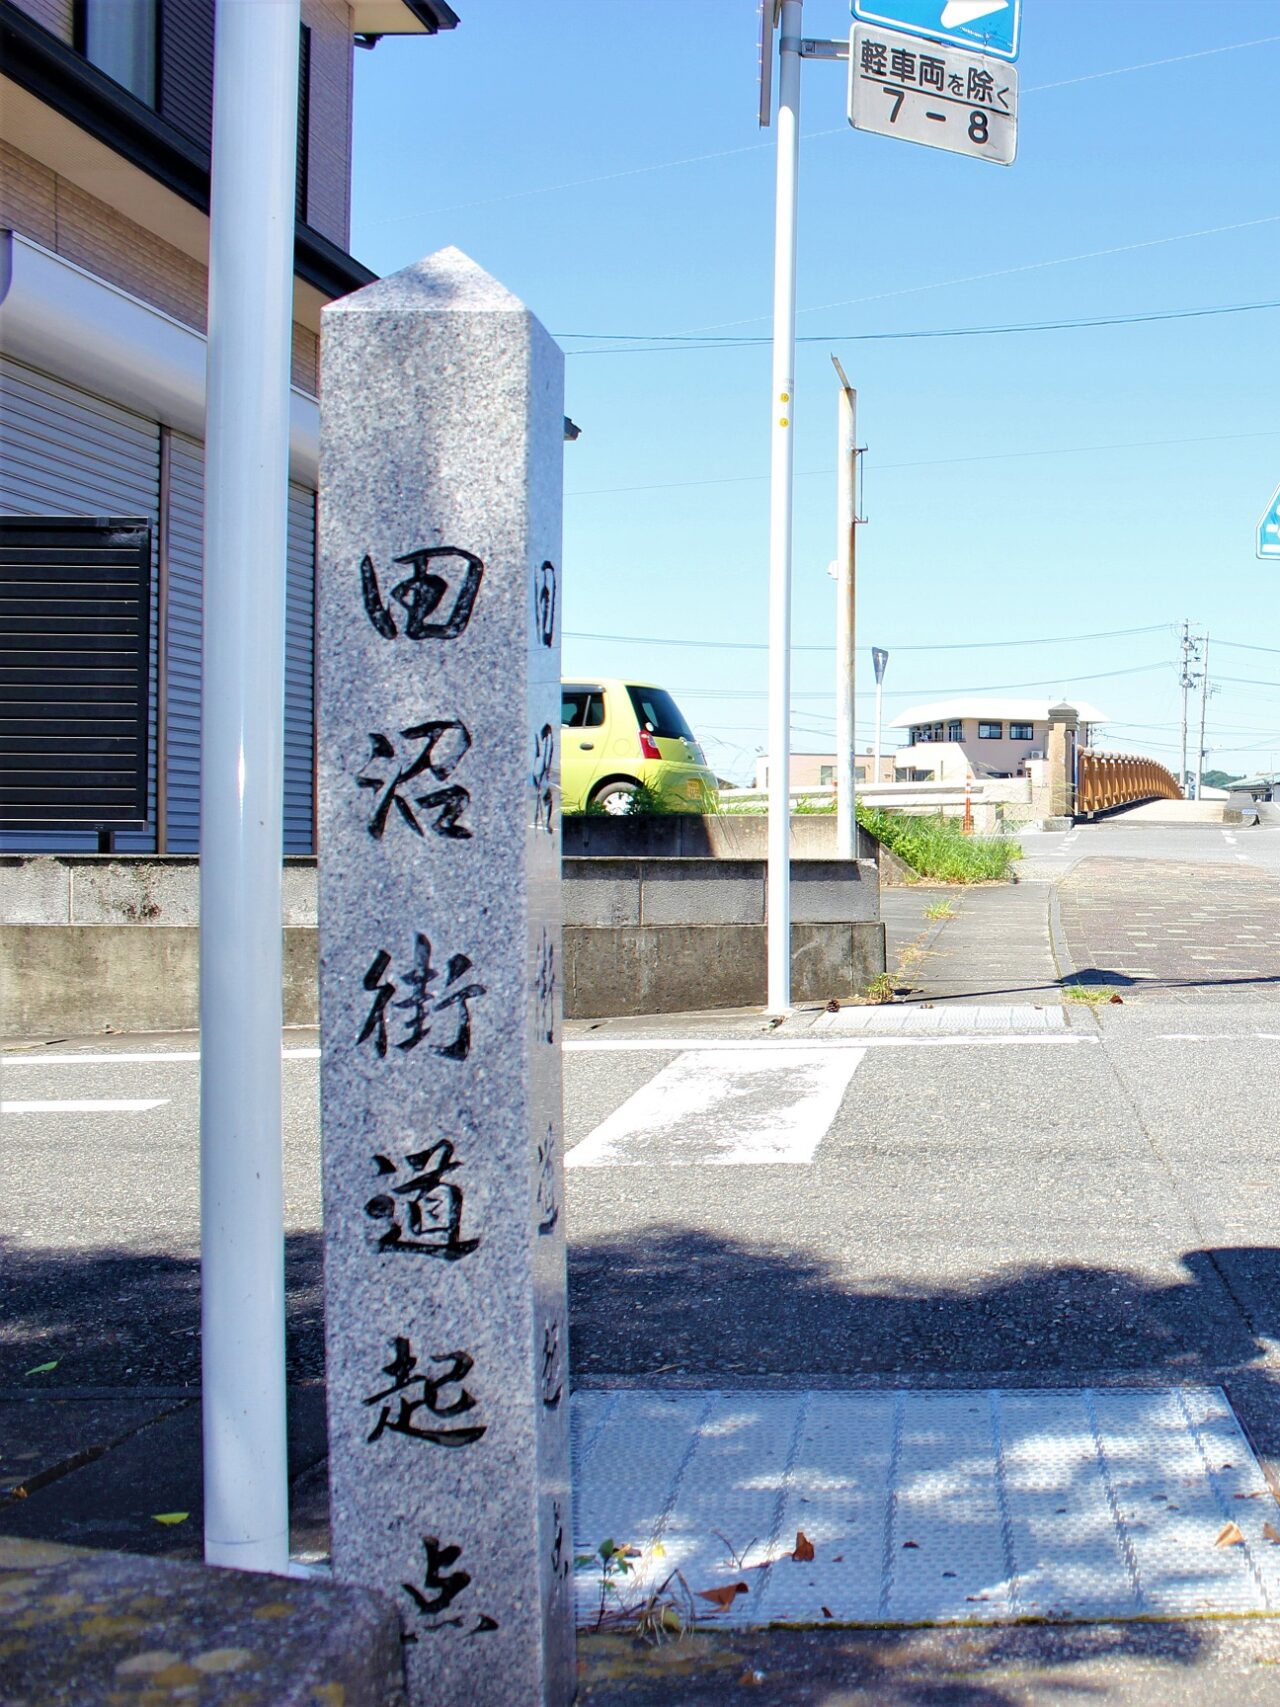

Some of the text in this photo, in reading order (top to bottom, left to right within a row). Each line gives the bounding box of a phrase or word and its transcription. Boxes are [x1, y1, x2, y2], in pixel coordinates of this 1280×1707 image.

[860, 38, 1009, 109] 軽車両を除く
[356, 546, 499, 1645] 田沼街道起点
